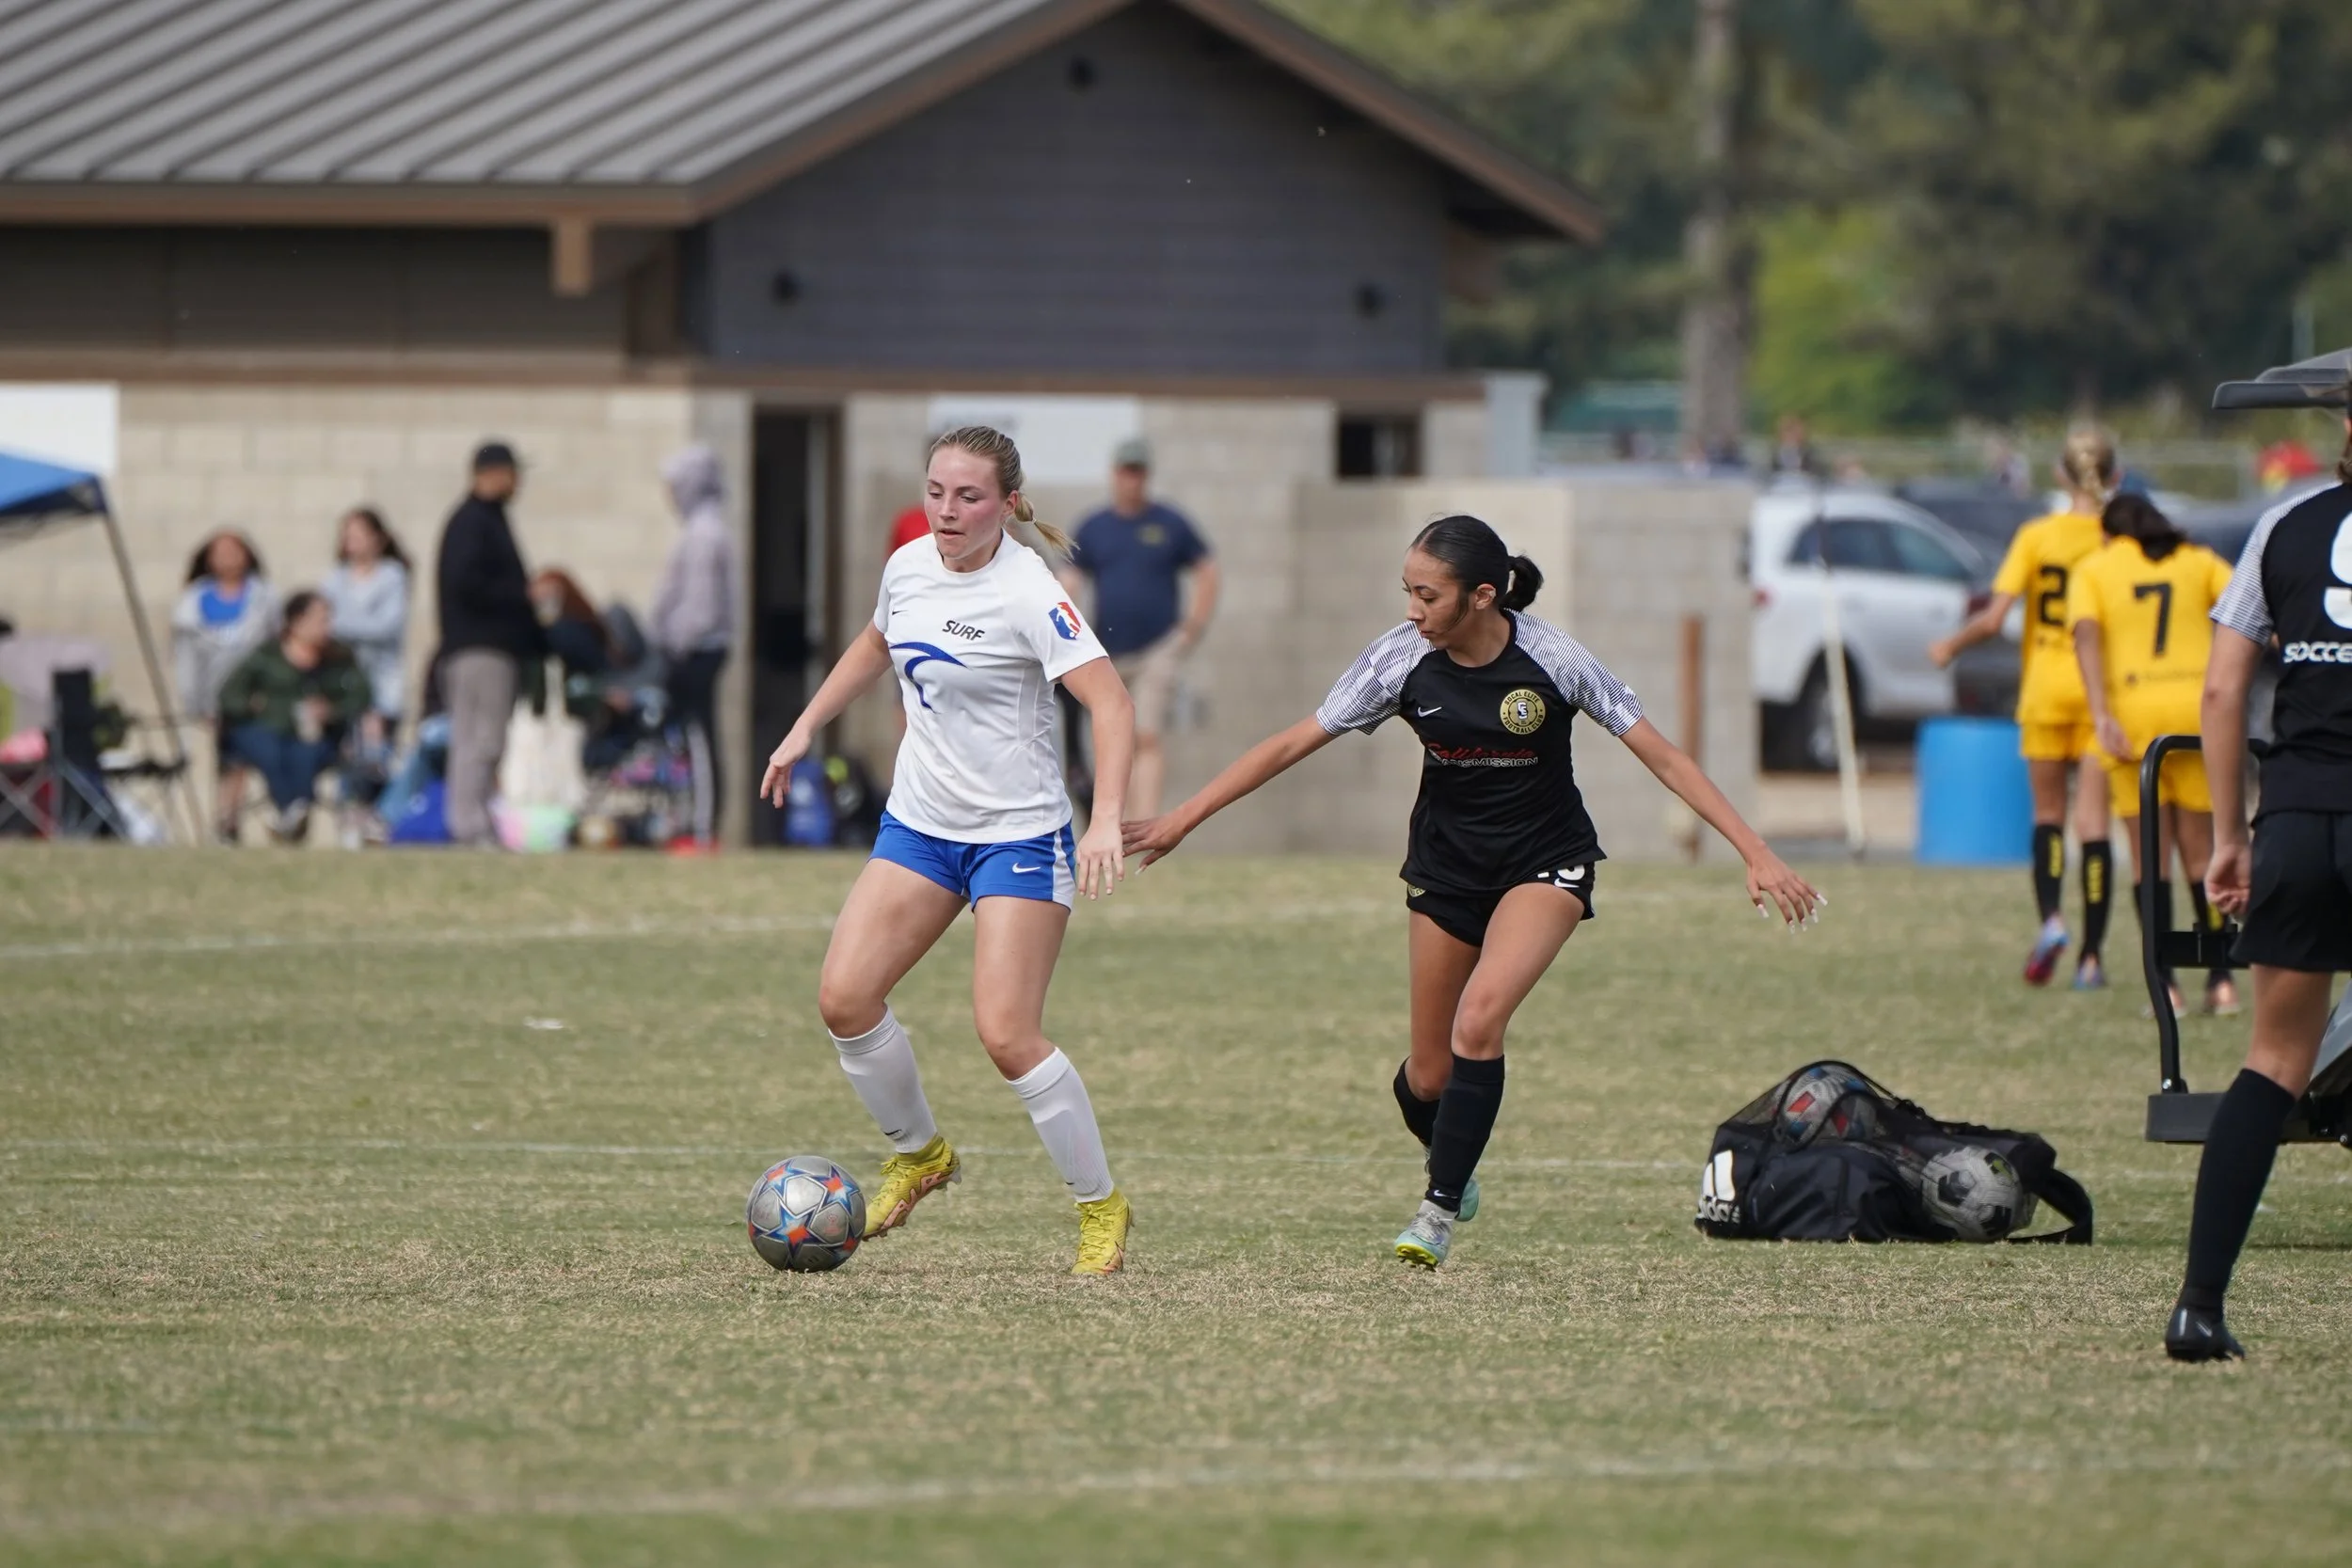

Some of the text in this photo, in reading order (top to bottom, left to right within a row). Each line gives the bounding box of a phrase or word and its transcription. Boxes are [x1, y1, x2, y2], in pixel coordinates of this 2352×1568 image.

[2039, 565, 2068, 626] 2
[2133, 580, 2172, 657] 7
[942, 620, 985, 641] SURF
[1523, 691, 1540, 704] ELITE
[1503, 714, 1544, 734] FOOTBALL CLUB
